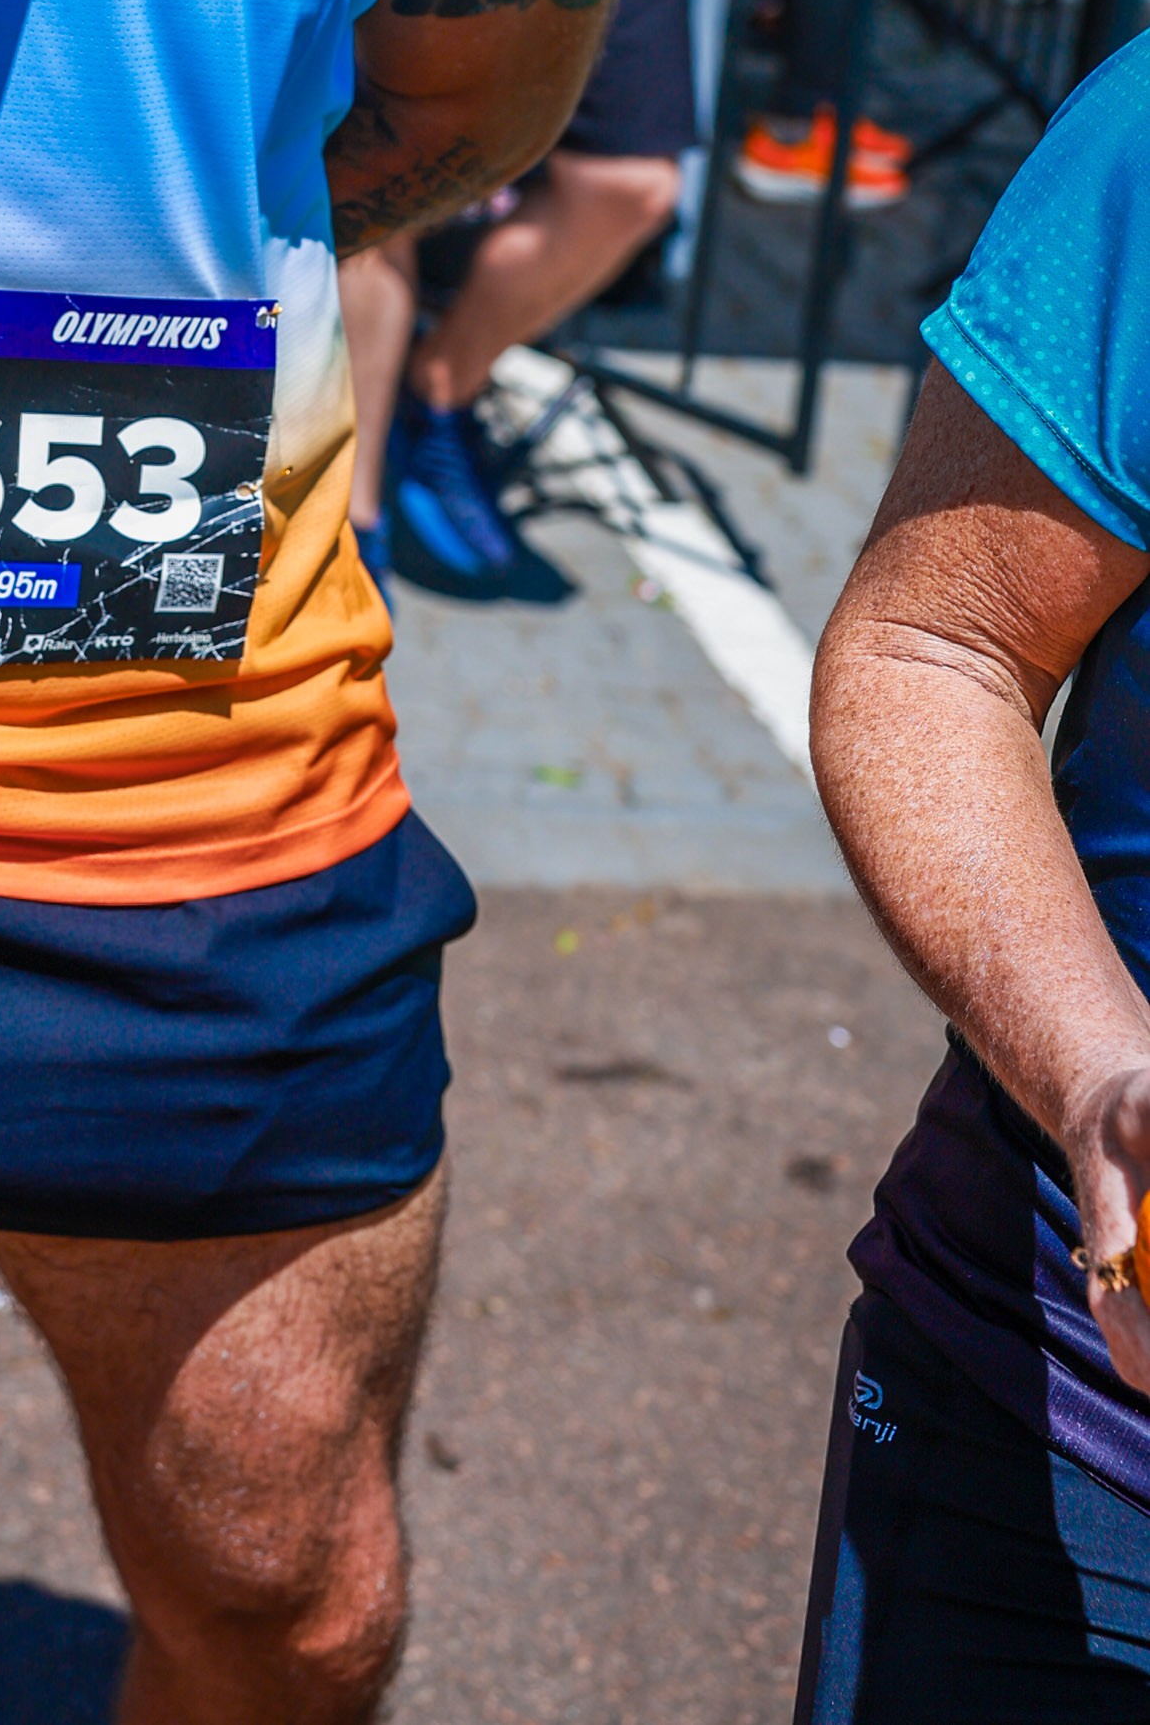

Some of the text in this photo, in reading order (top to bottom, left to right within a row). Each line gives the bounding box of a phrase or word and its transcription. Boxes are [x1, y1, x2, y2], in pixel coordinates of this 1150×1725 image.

[52, 310, 228, 351] OLYMPIKUS
[42, 638, 73, 651] Raia
[95, 635, 135, 648] KTO
